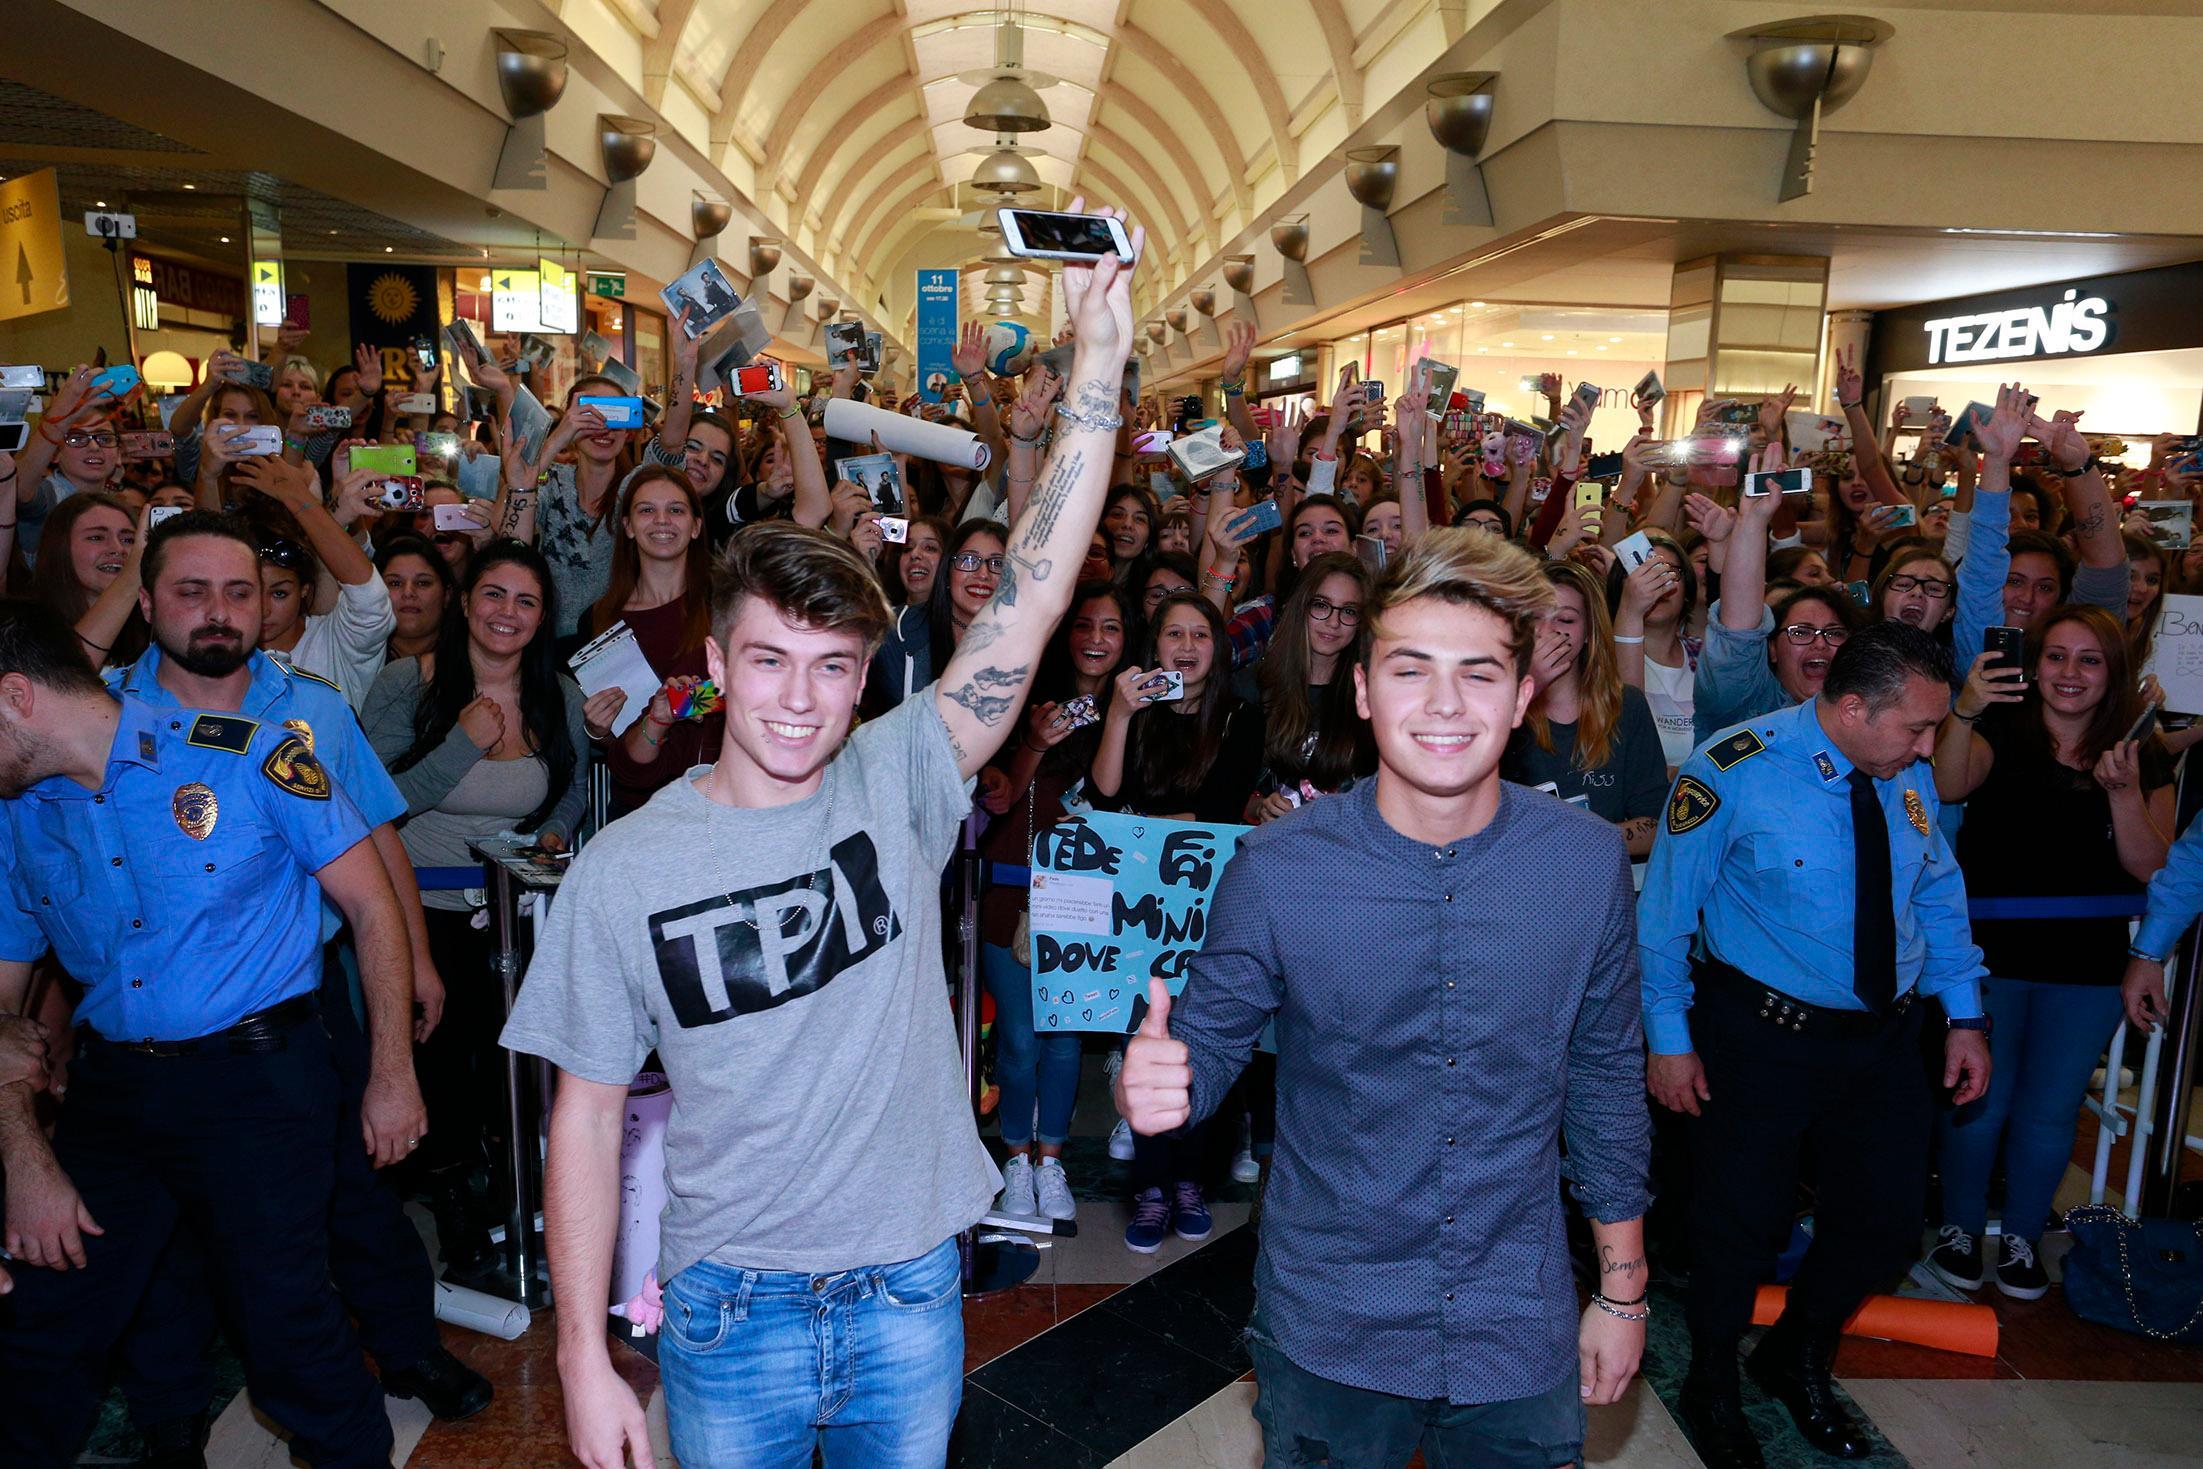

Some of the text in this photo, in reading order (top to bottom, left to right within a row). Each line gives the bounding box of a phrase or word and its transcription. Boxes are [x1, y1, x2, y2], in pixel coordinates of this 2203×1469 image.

[3, 198, 32, 224] uscita
[921, 285, 953, 293] ottobre
[931, 275, 943, 285] 11
[1036, 934, 1122, 975] DOVE
